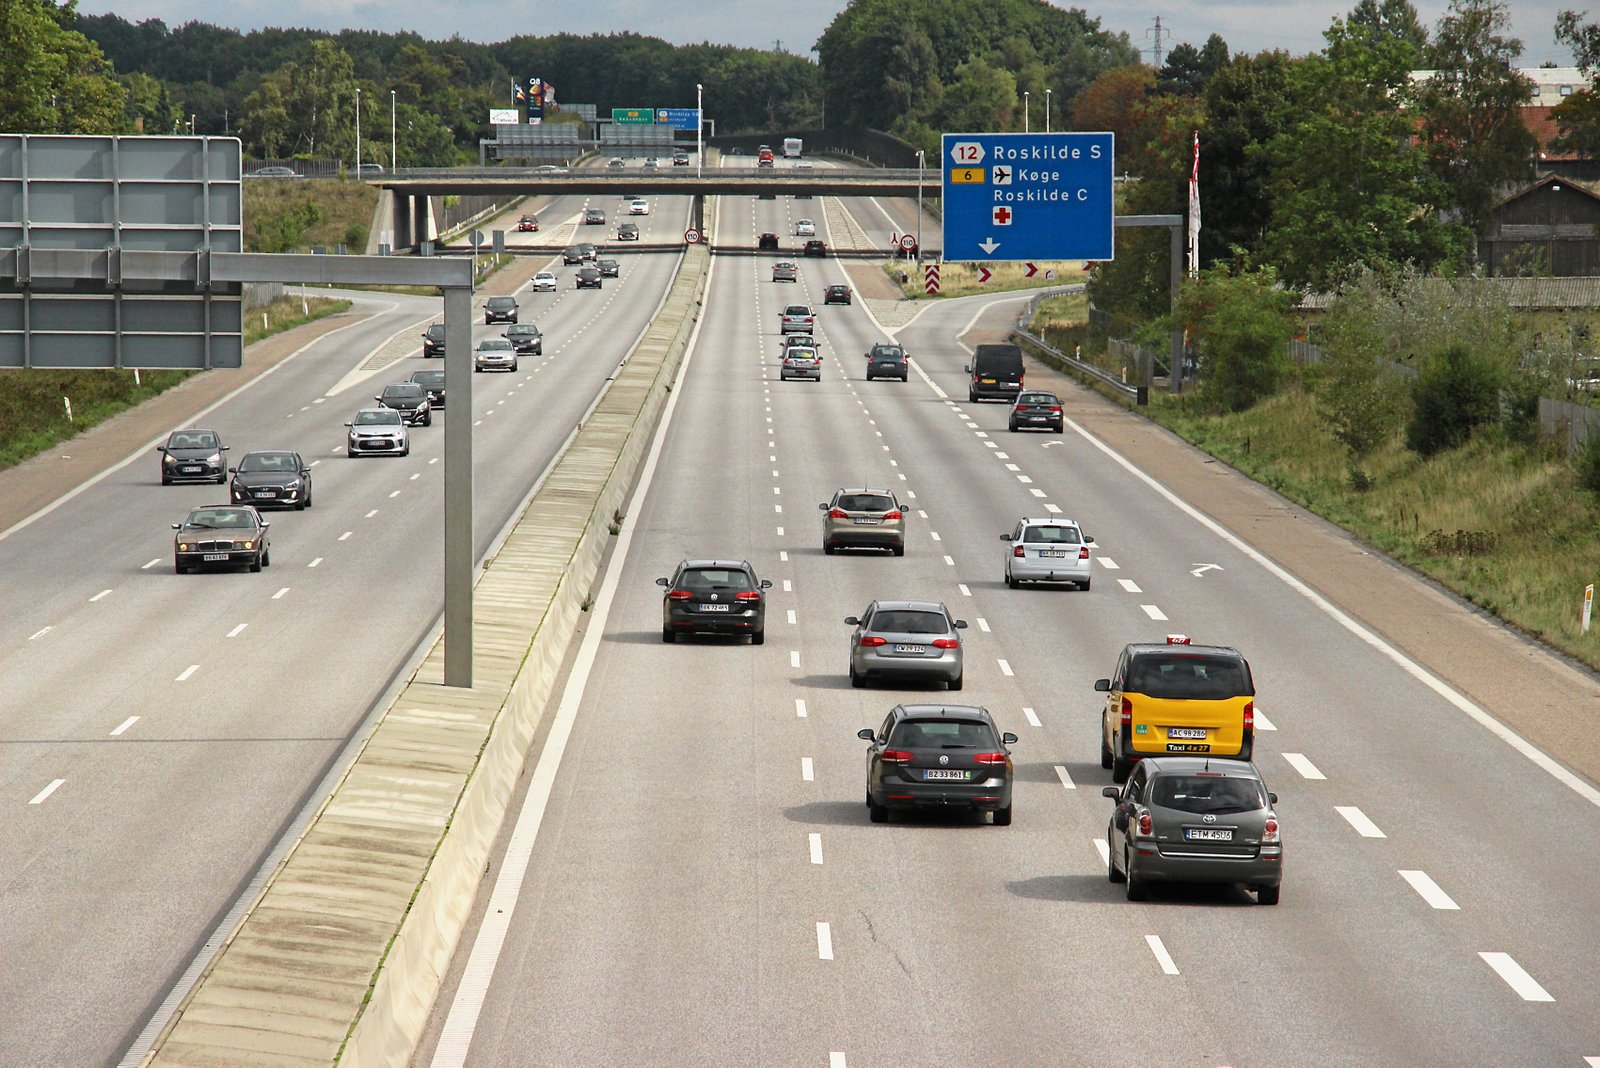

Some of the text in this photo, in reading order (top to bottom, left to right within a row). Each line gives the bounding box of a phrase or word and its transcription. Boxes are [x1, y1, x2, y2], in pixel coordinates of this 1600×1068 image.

[959, 146, 978, 160] 12
[994, 145, 1102, 160] Roskilde S
[964, 170, 972, 181] 6
[1019, 168, 1060, 183] Køge
[994, 189, 1088, 201] Roskilde C
[1183, 729, 1192, 737] 98
[1192, 730, 1206, 738] 286
[928, 770, 938, 778] BZ
[949, 771, 962, 779] 861
[1191, 830, 1208, 839] ETM
